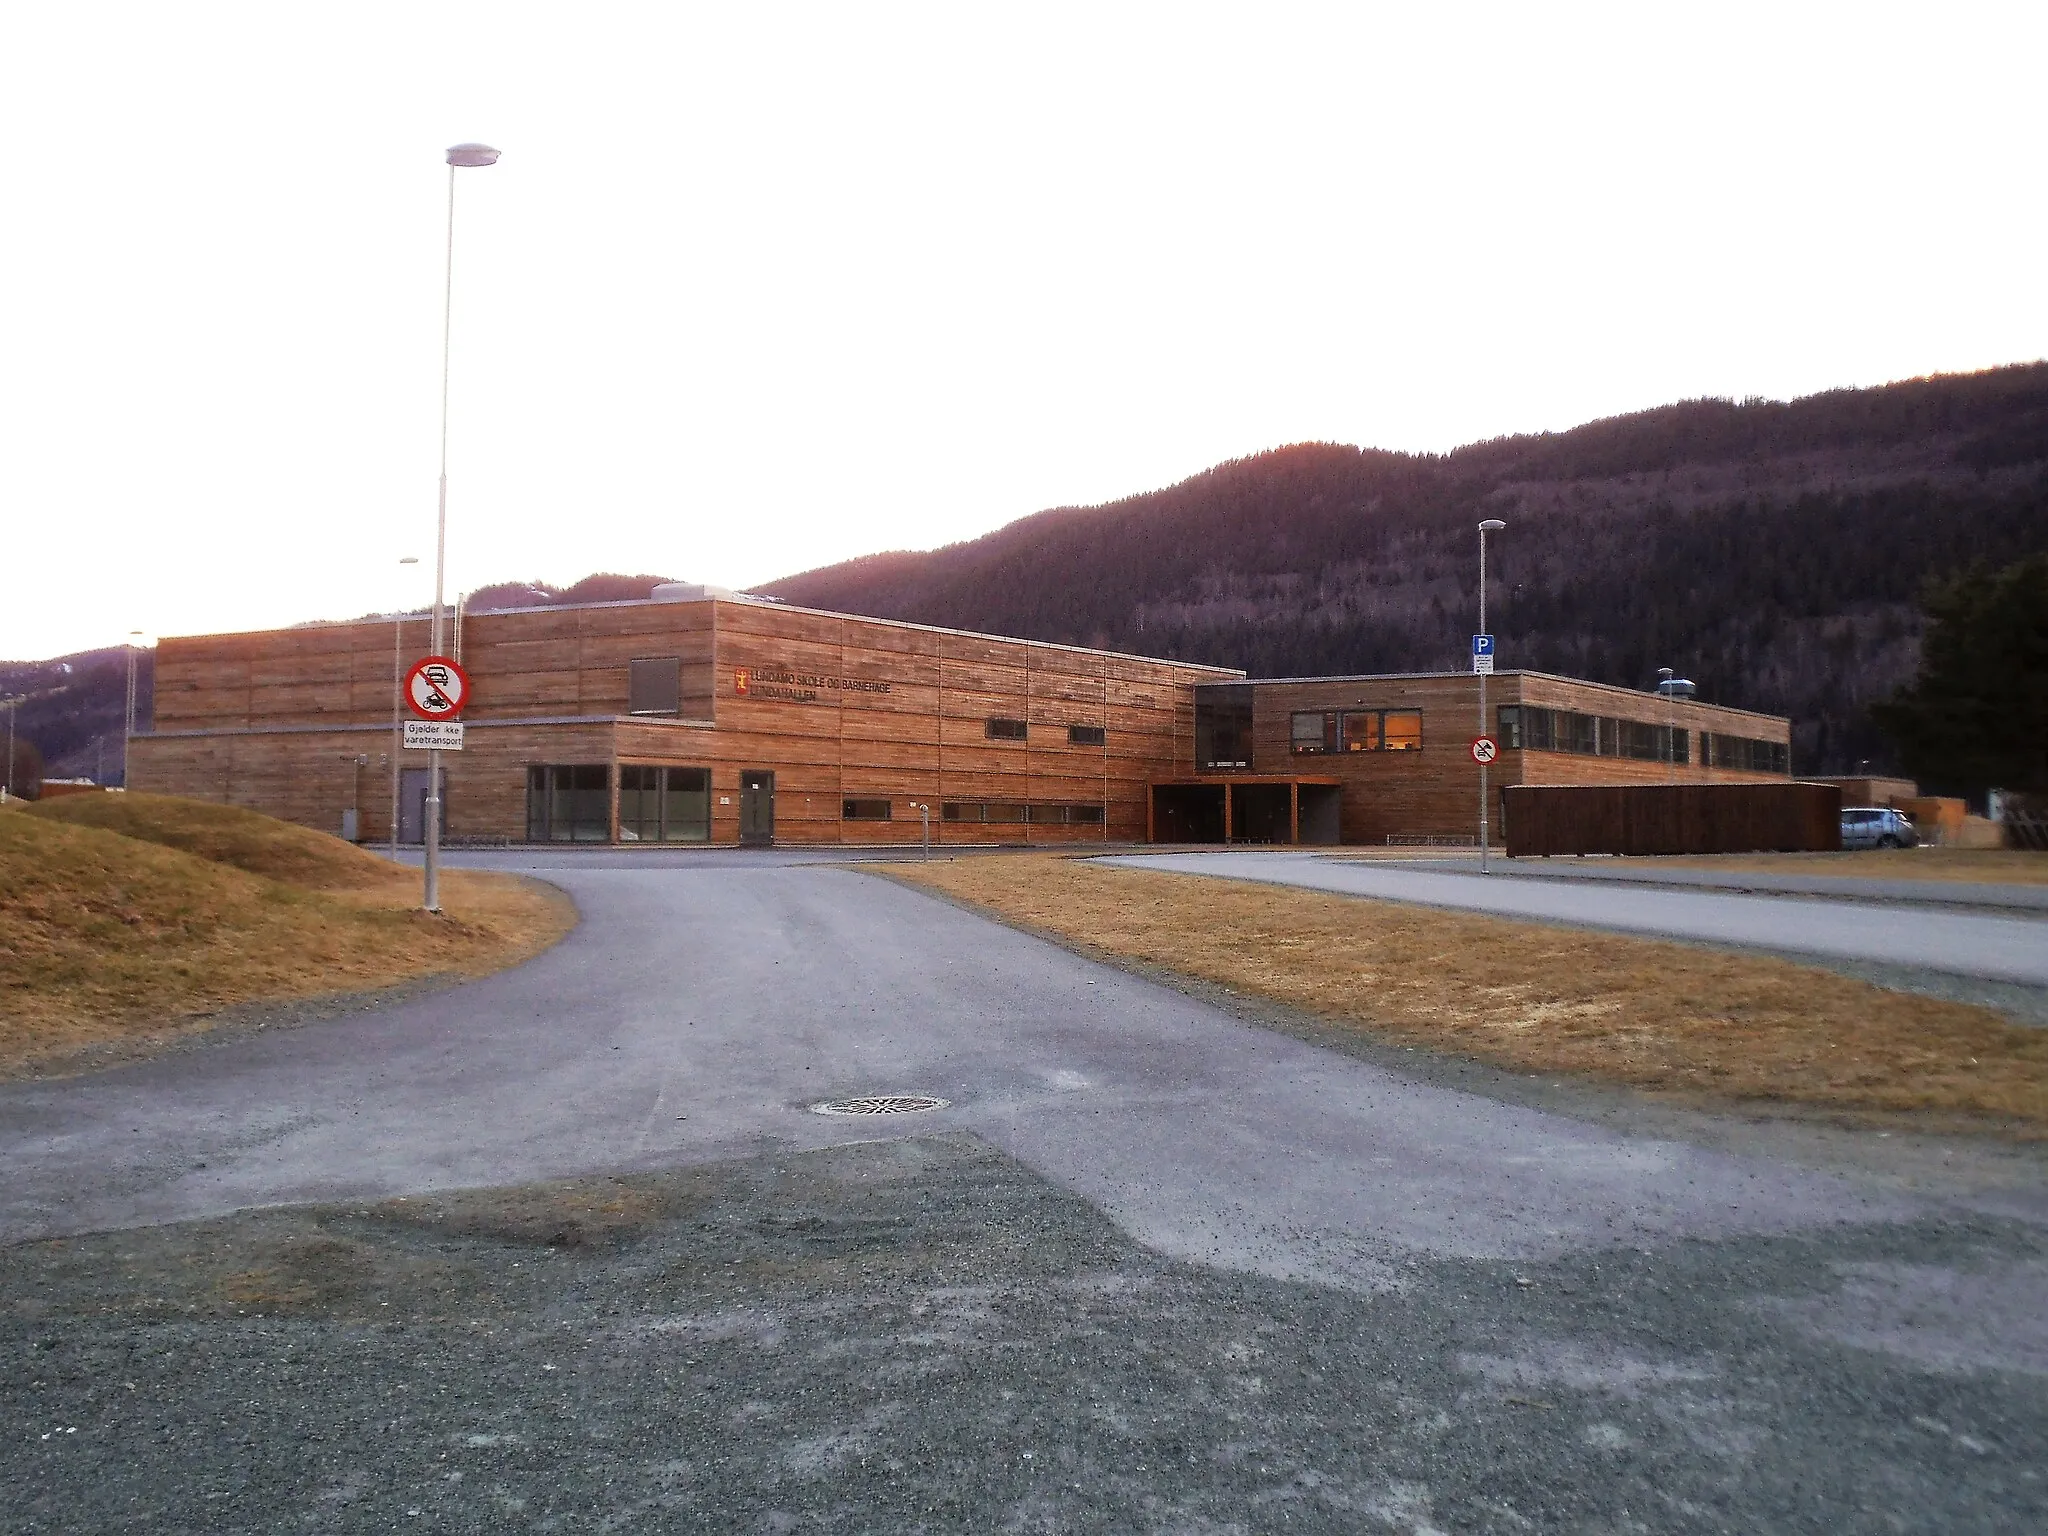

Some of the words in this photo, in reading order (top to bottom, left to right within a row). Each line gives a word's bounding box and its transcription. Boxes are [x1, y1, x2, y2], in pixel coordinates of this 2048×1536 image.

[1478, 637, 1489, 653] P
[750, 670, 795, 685] LUNDAMO
[796, 674, 825, 688] SKOLE
[827, 678, 840, 689] OG
[842, 679, 891, 694] BARNEHAGE
[408, 724, 440, 735] Gjelder
[444, 725, 460, 735] ikke
[404, 736, 462, 746] varetransport
